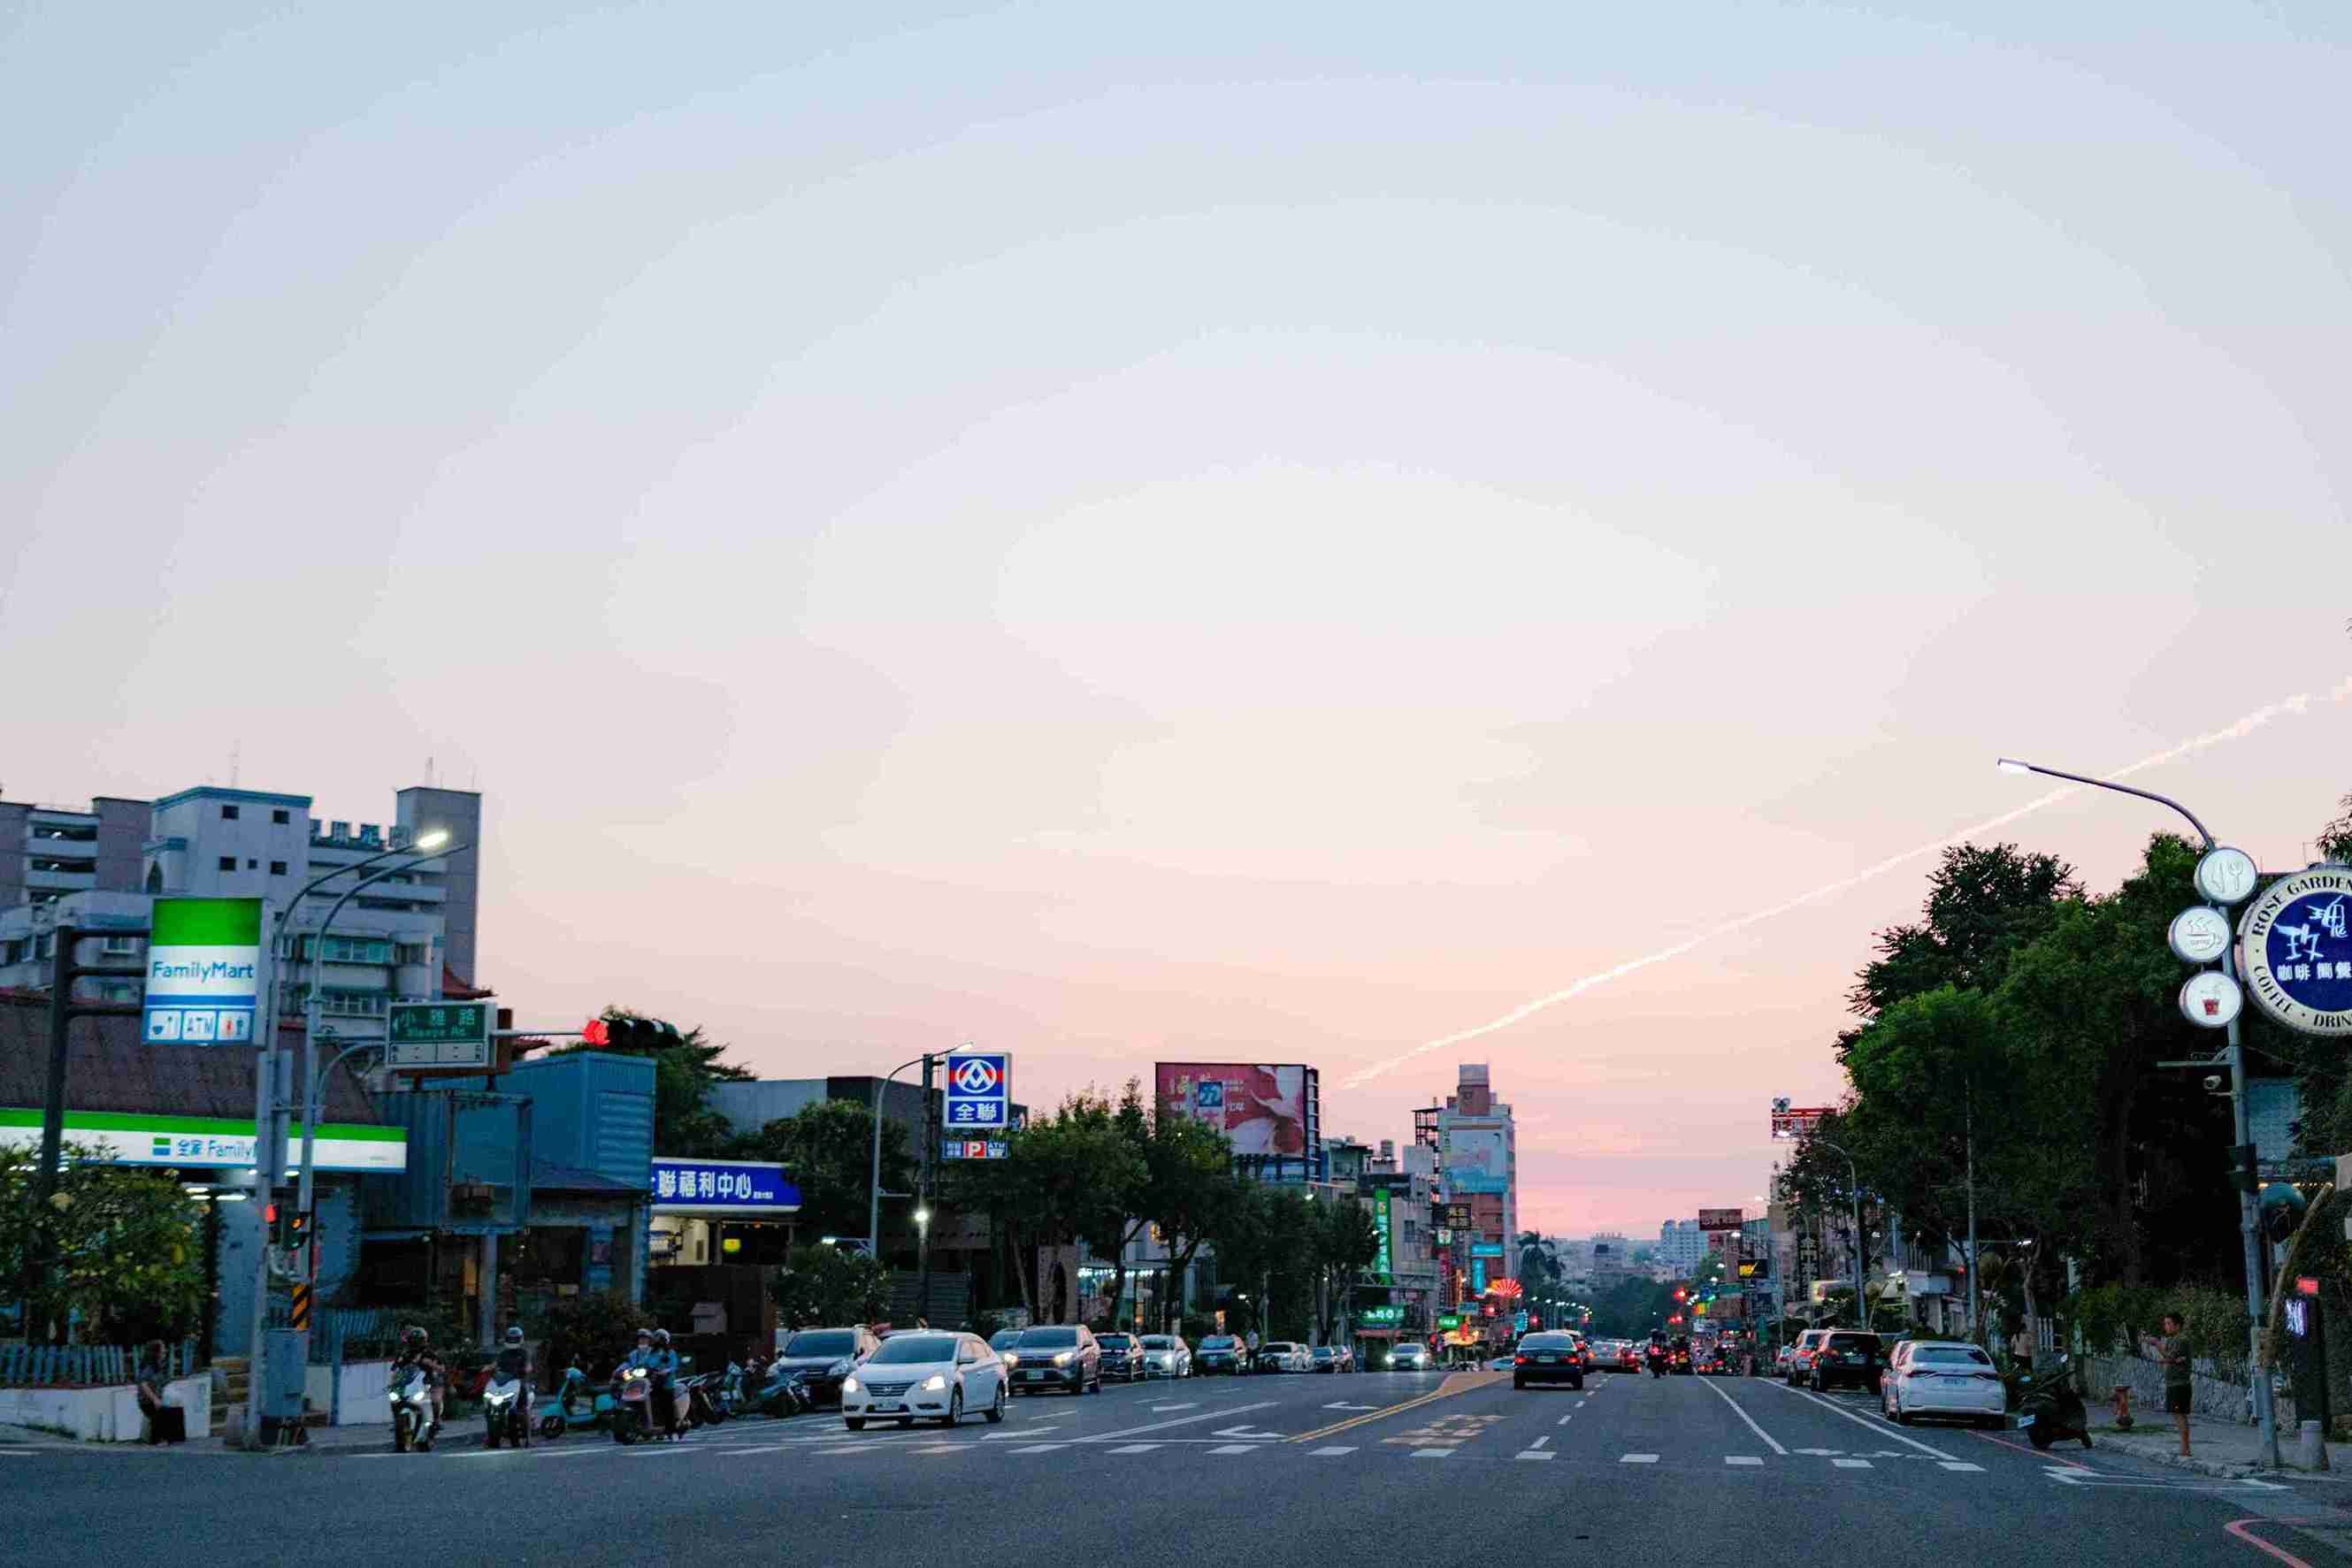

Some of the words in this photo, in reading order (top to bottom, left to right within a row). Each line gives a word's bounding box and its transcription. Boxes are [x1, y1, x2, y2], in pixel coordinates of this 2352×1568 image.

[2252, 892, 2284, 936] ROSE
[151, 960, 255, 983] FamilyMart
[186, 1017, 213, 1033] ATM
[955, 1102, 997, 1121] 全聯
[651, 1169, 752, 1199] 聯福利中心
